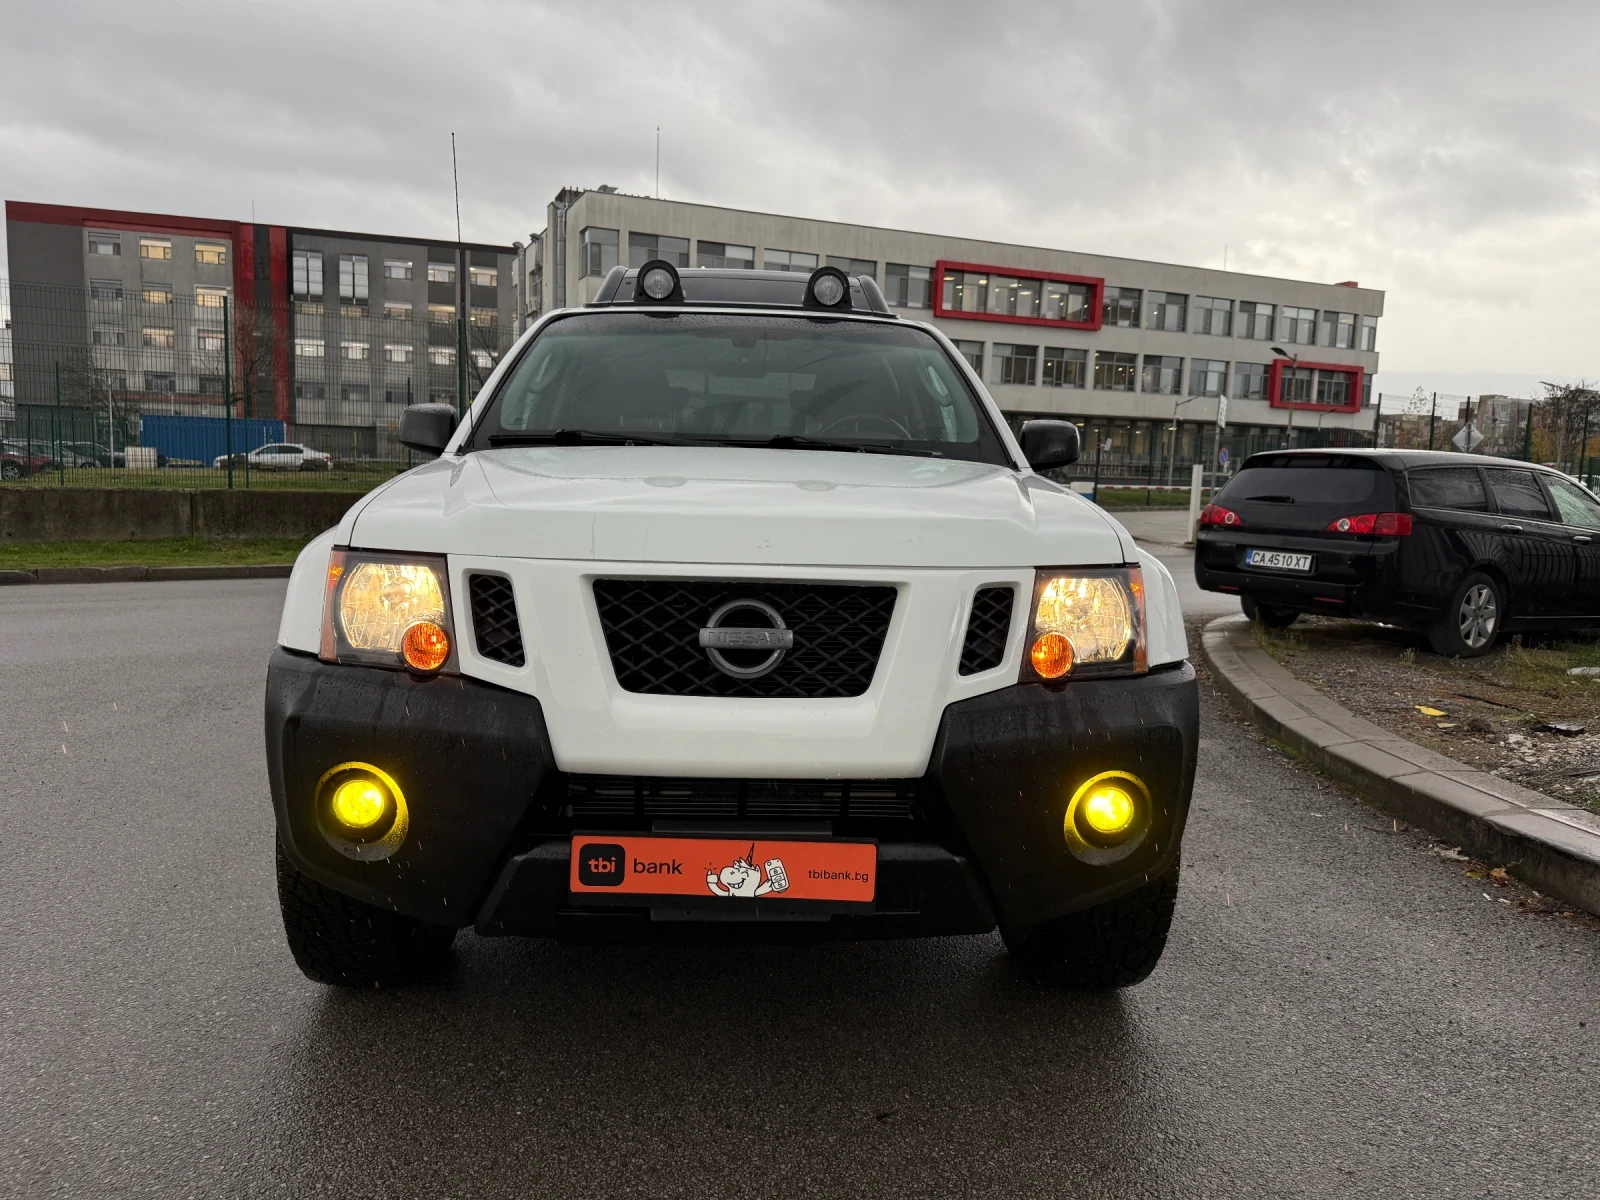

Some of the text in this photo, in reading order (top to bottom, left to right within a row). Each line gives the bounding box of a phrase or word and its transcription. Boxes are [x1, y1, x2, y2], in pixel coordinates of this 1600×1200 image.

[1252, 552, 1265, 565] CA
[1268, 553, 1293, 567] 4510
[1294, 555, 1309, 568] XT
[708, 631, 784, 645] NISSAN
[588, 857, 683, 876] tbi bank
[807, 869, 869, 883] tbibank.bg
